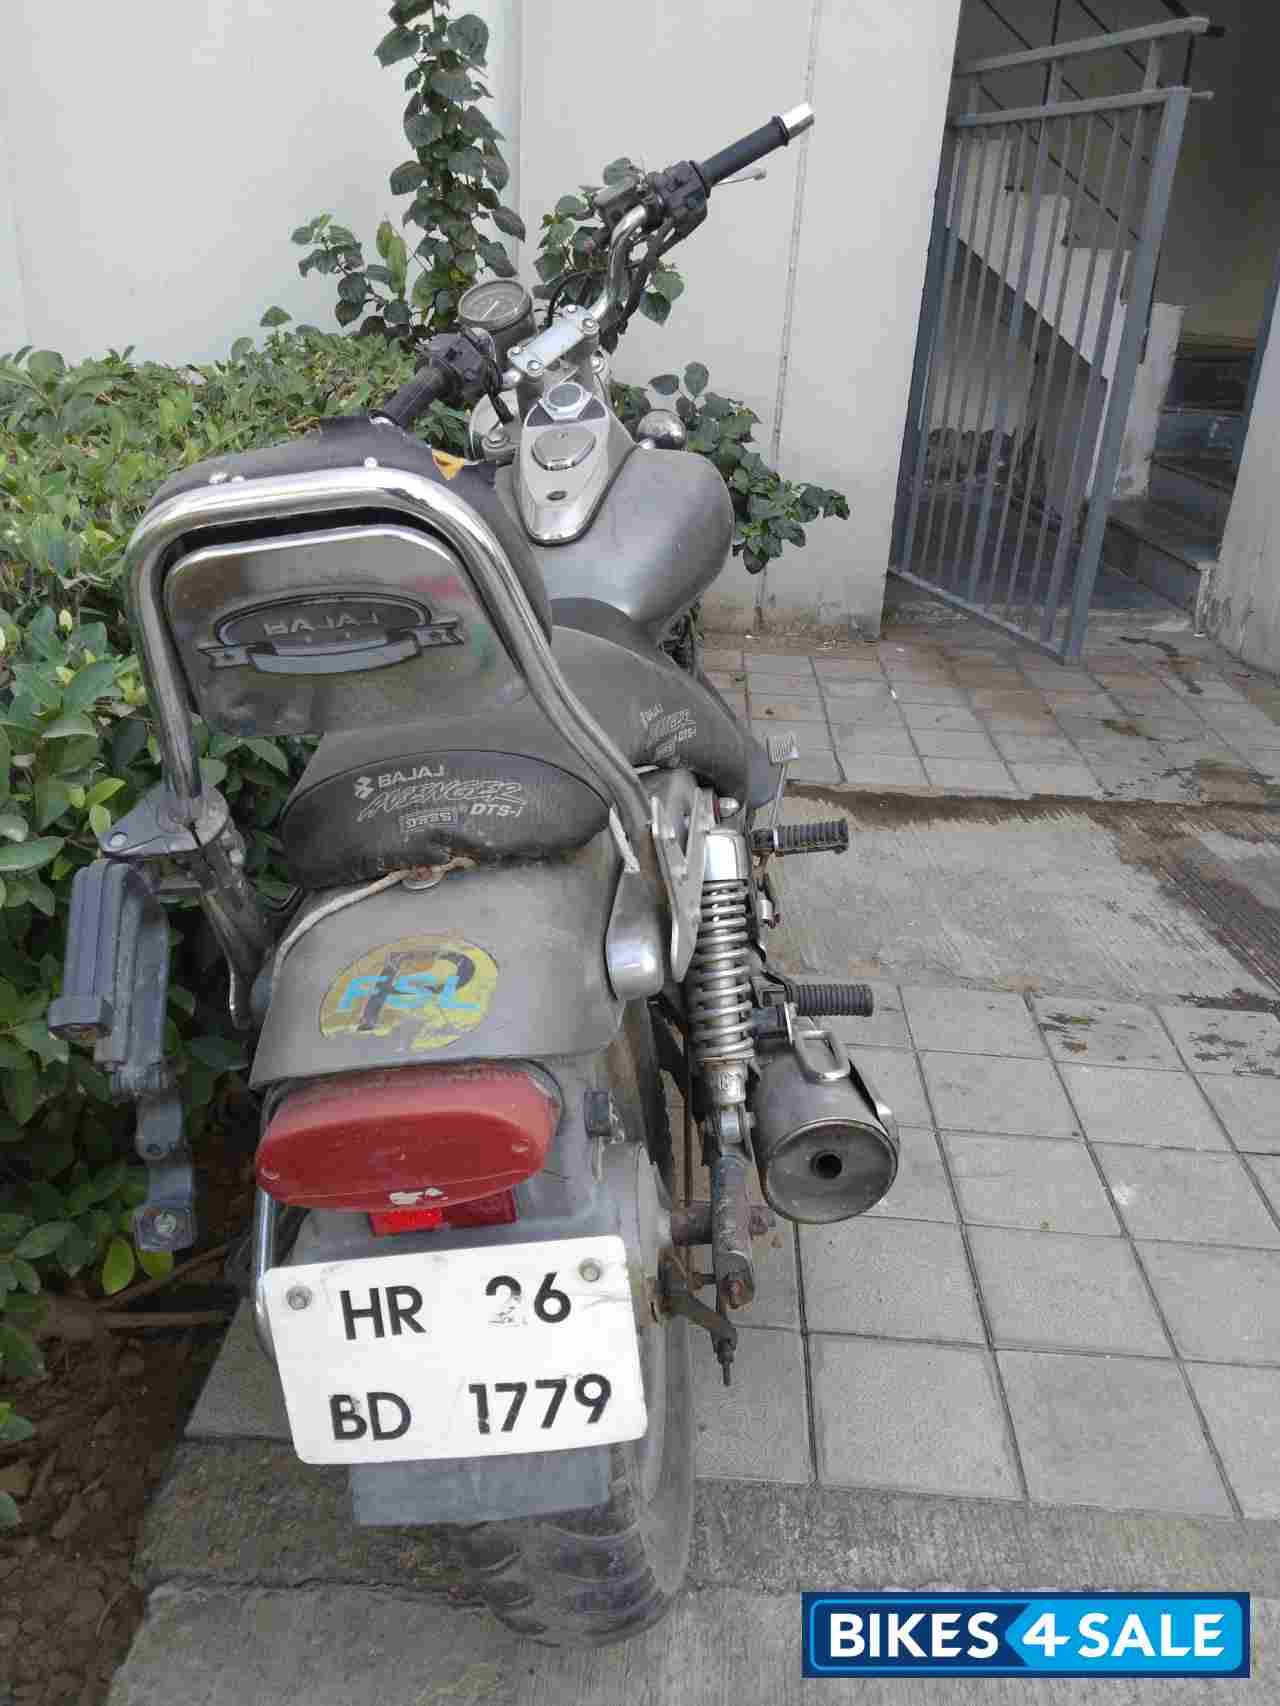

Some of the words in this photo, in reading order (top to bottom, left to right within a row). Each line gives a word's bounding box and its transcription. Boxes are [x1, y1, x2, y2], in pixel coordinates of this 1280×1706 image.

[264, 612, 379, 636] BAJAJ
[377, 764, 446, 789] BAJAJ
[335, 974, 481, 1012] FSL
[340, 1284, 427, 1340] HR
[329, 1391, 412, 1441] BD
[468, 1373, 613, 1434] 1779
